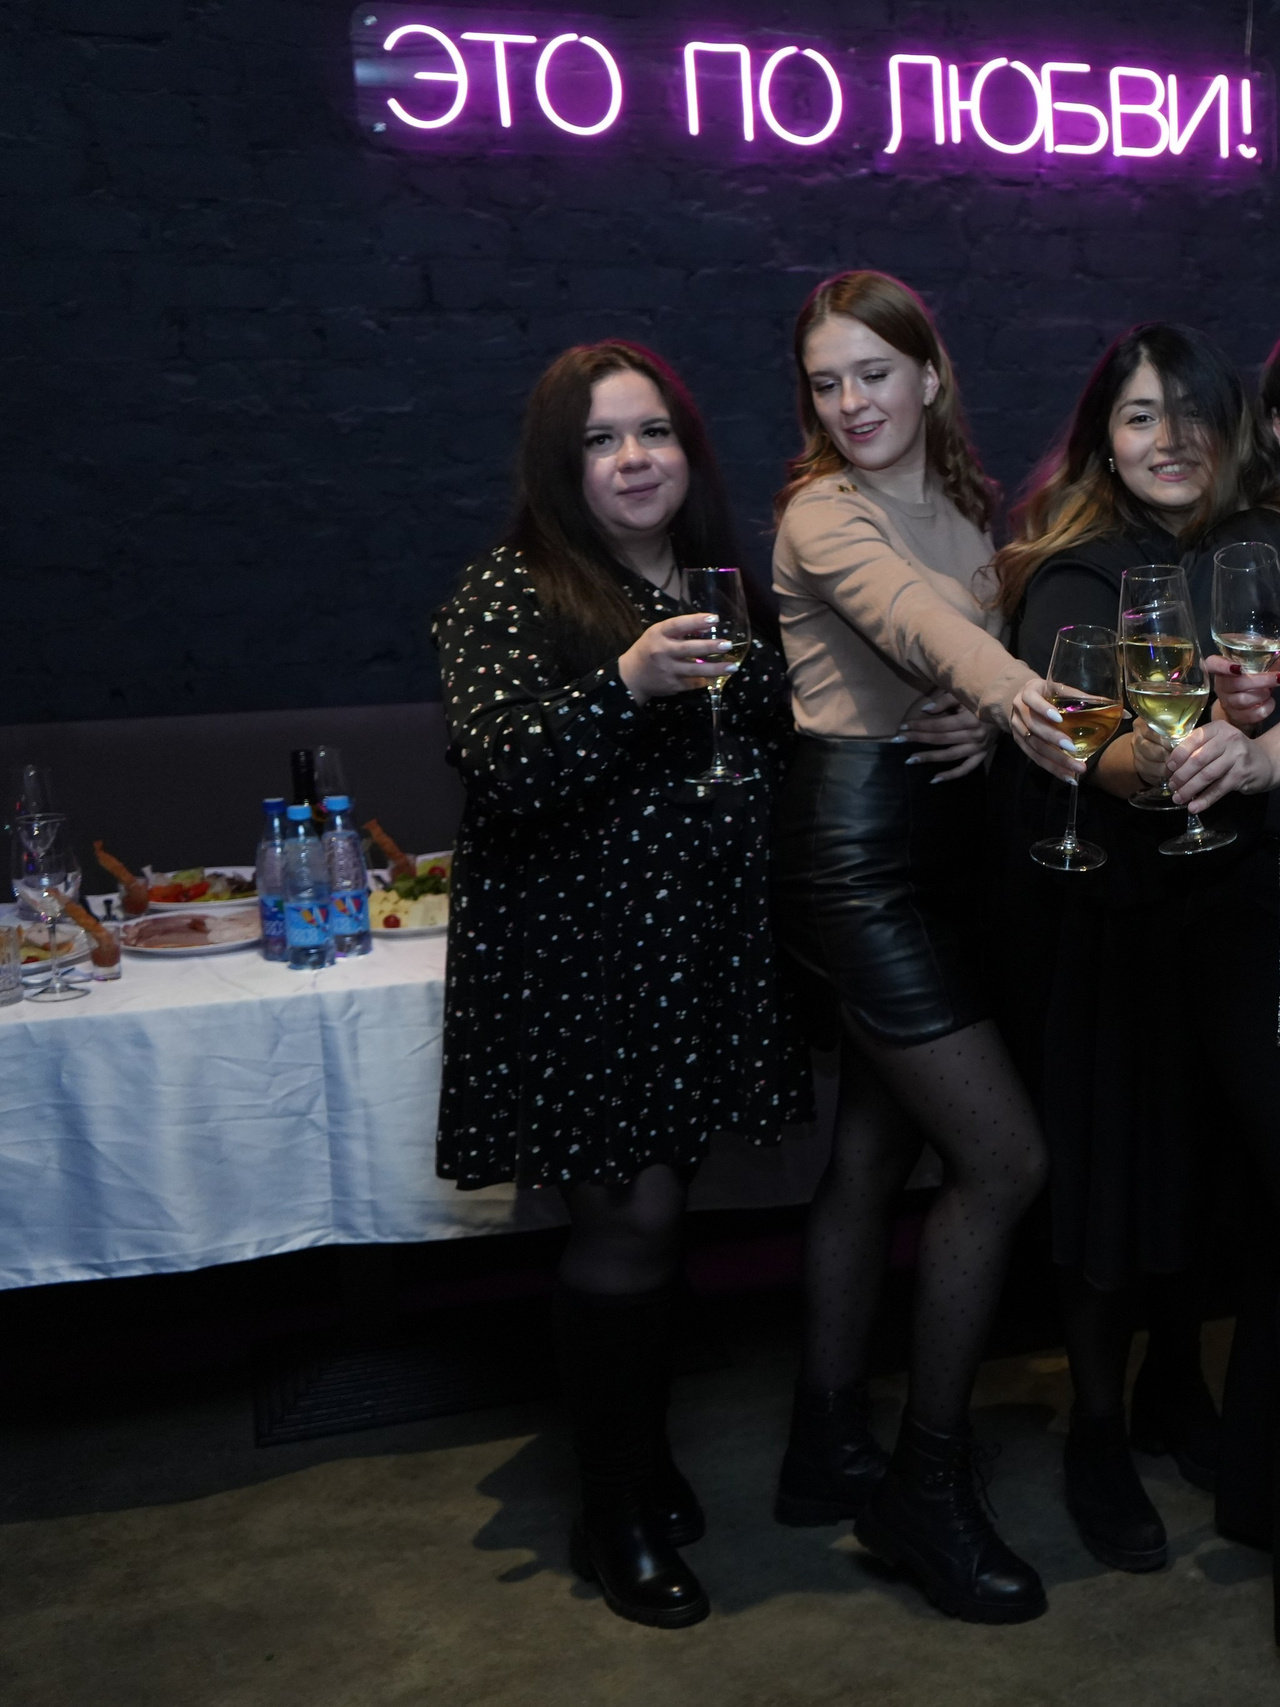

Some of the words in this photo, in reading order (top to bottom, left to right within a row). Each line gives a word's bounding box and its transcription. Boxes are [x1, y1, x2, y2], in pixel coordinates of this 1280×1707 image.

[382, 22, 624, 137] ЭТО
[683, 40, 844, 146] ПО
[883, 53, 1258, 160] ЛЮБВИ!
